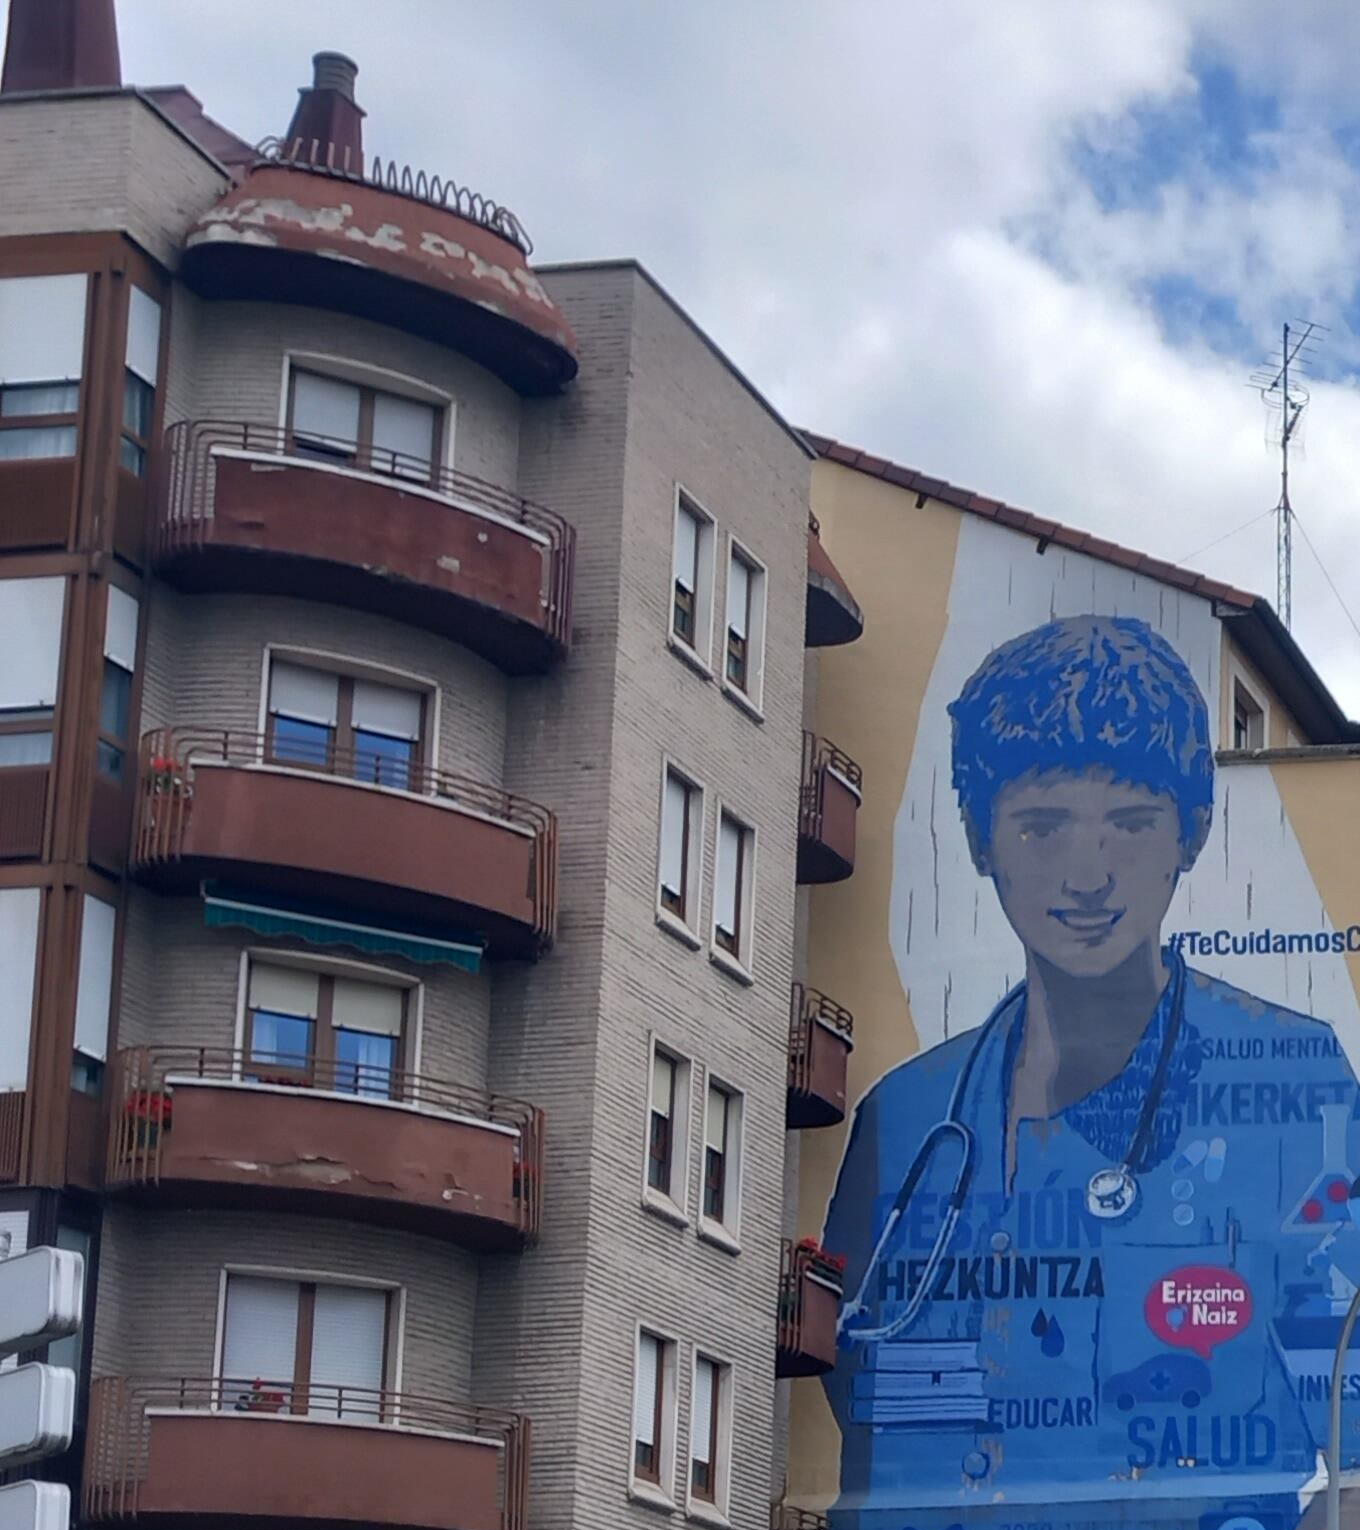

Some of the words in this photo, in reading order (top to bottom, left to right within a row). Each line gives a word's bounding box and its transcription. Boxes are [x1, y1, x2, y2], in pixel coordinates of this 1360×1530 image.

[1202, 1037, 1264, 1060] SALUD
[1271, 1036, 1343, 1058] MENTAL
[877, 1256, 1105, 1302] HEZKUNTZA
[1162, 1281, 1245, 1305] Erizaina
[1191, 1305, 1238, 1326] Naiz
[988, 1397, 1094, 1430] EDUCAR
[1128, 1415, 1277, 1469] SALUD
